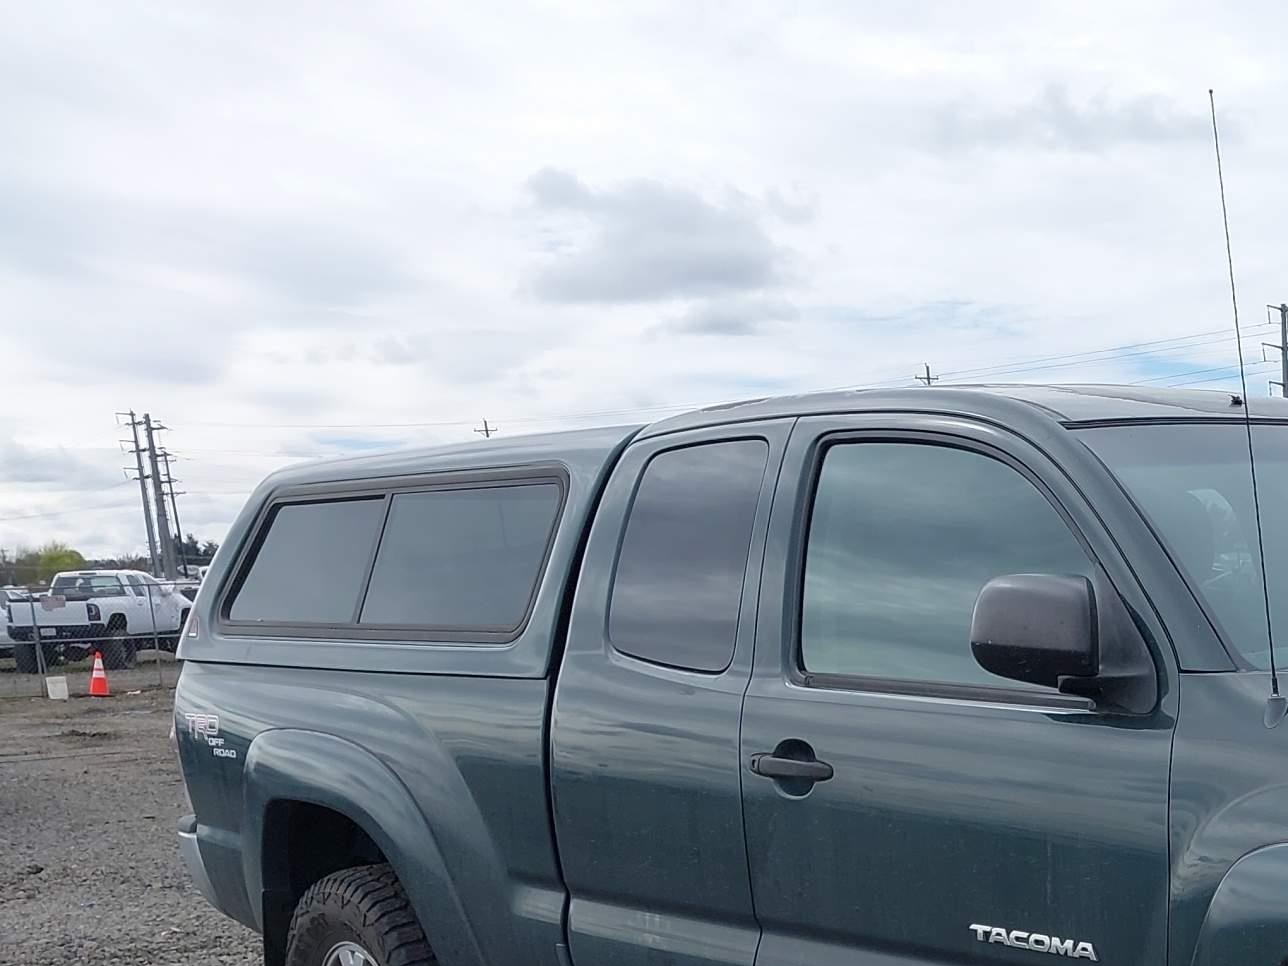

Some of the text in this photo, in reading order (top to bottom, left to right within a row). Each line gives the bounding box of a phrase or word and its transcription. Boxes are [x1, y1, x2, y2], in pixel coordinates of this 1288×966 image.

[185, 713, 219, 740] TRD
[208, 738, 225, 746] OFF
[213, 748, 237, 758] ROAD
[969, 923, 1099, 961] TACOMA
